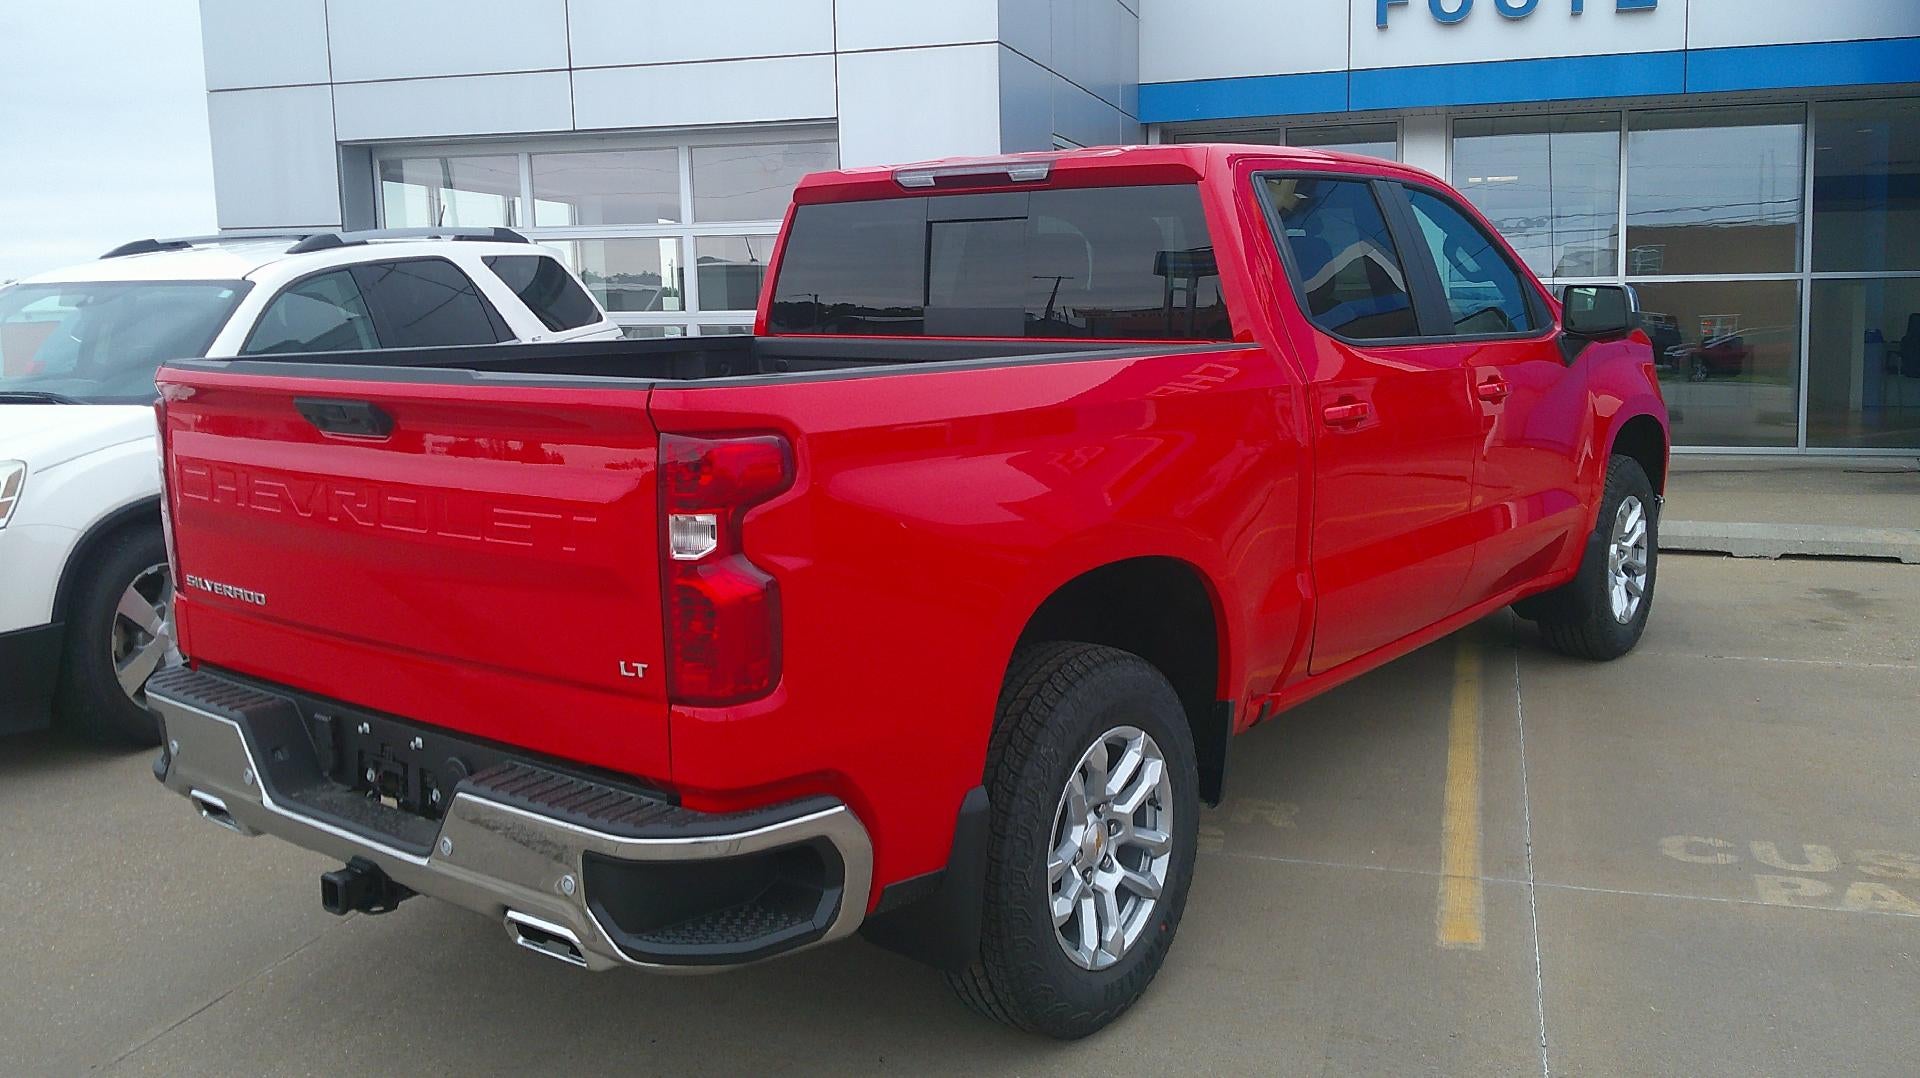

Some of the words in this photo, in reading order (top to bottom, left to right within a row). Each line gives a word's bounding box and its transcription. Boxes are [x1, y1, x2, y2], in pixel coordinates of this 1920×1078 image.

[178, 463, 598, 551] CHEVROLET
[186, 574, 266, 605] SILVERADO
[619, 660, 648, 678] LT
